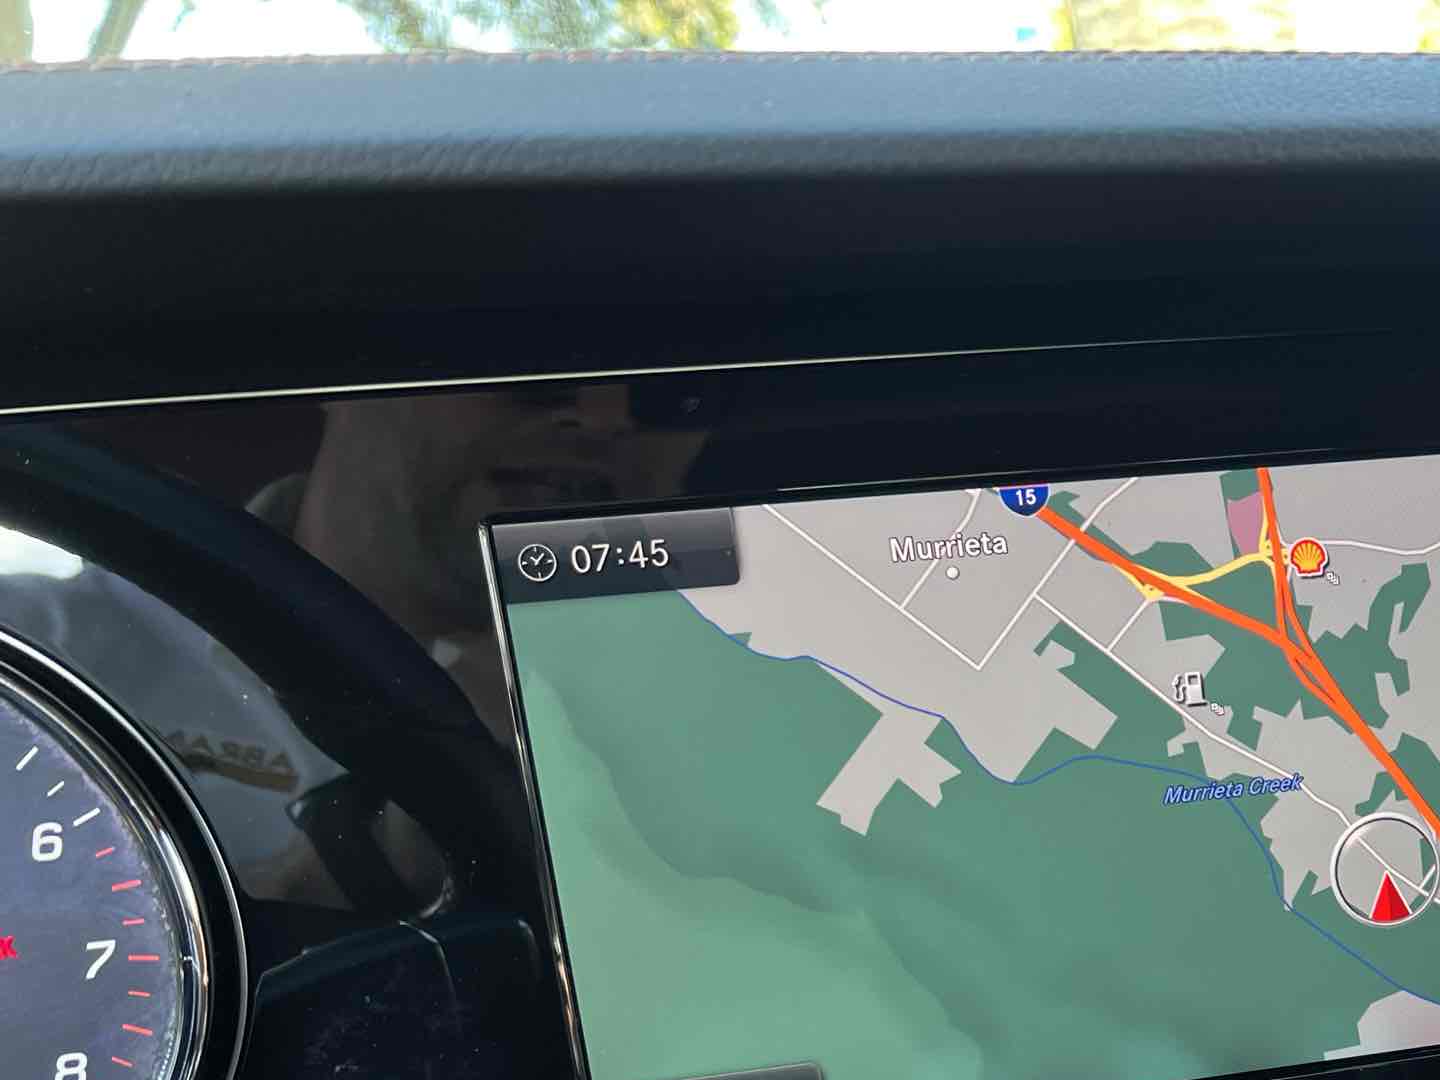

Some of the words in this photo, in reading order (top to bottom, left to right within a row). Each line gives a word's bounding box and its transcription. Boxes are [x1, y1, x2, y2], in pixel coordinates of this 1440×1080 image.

[1015, 488, 1037, 506] 15
[570, 538, 670, 574] 07:45
[889, 531, 1009, 563] Murrieta
[1163, 780, 1244, 806] Murrieta
[1247, 773, 1303, 797] Creek
[32, 822, 63, 861] 6
[84, 939, 116, 980] 7
